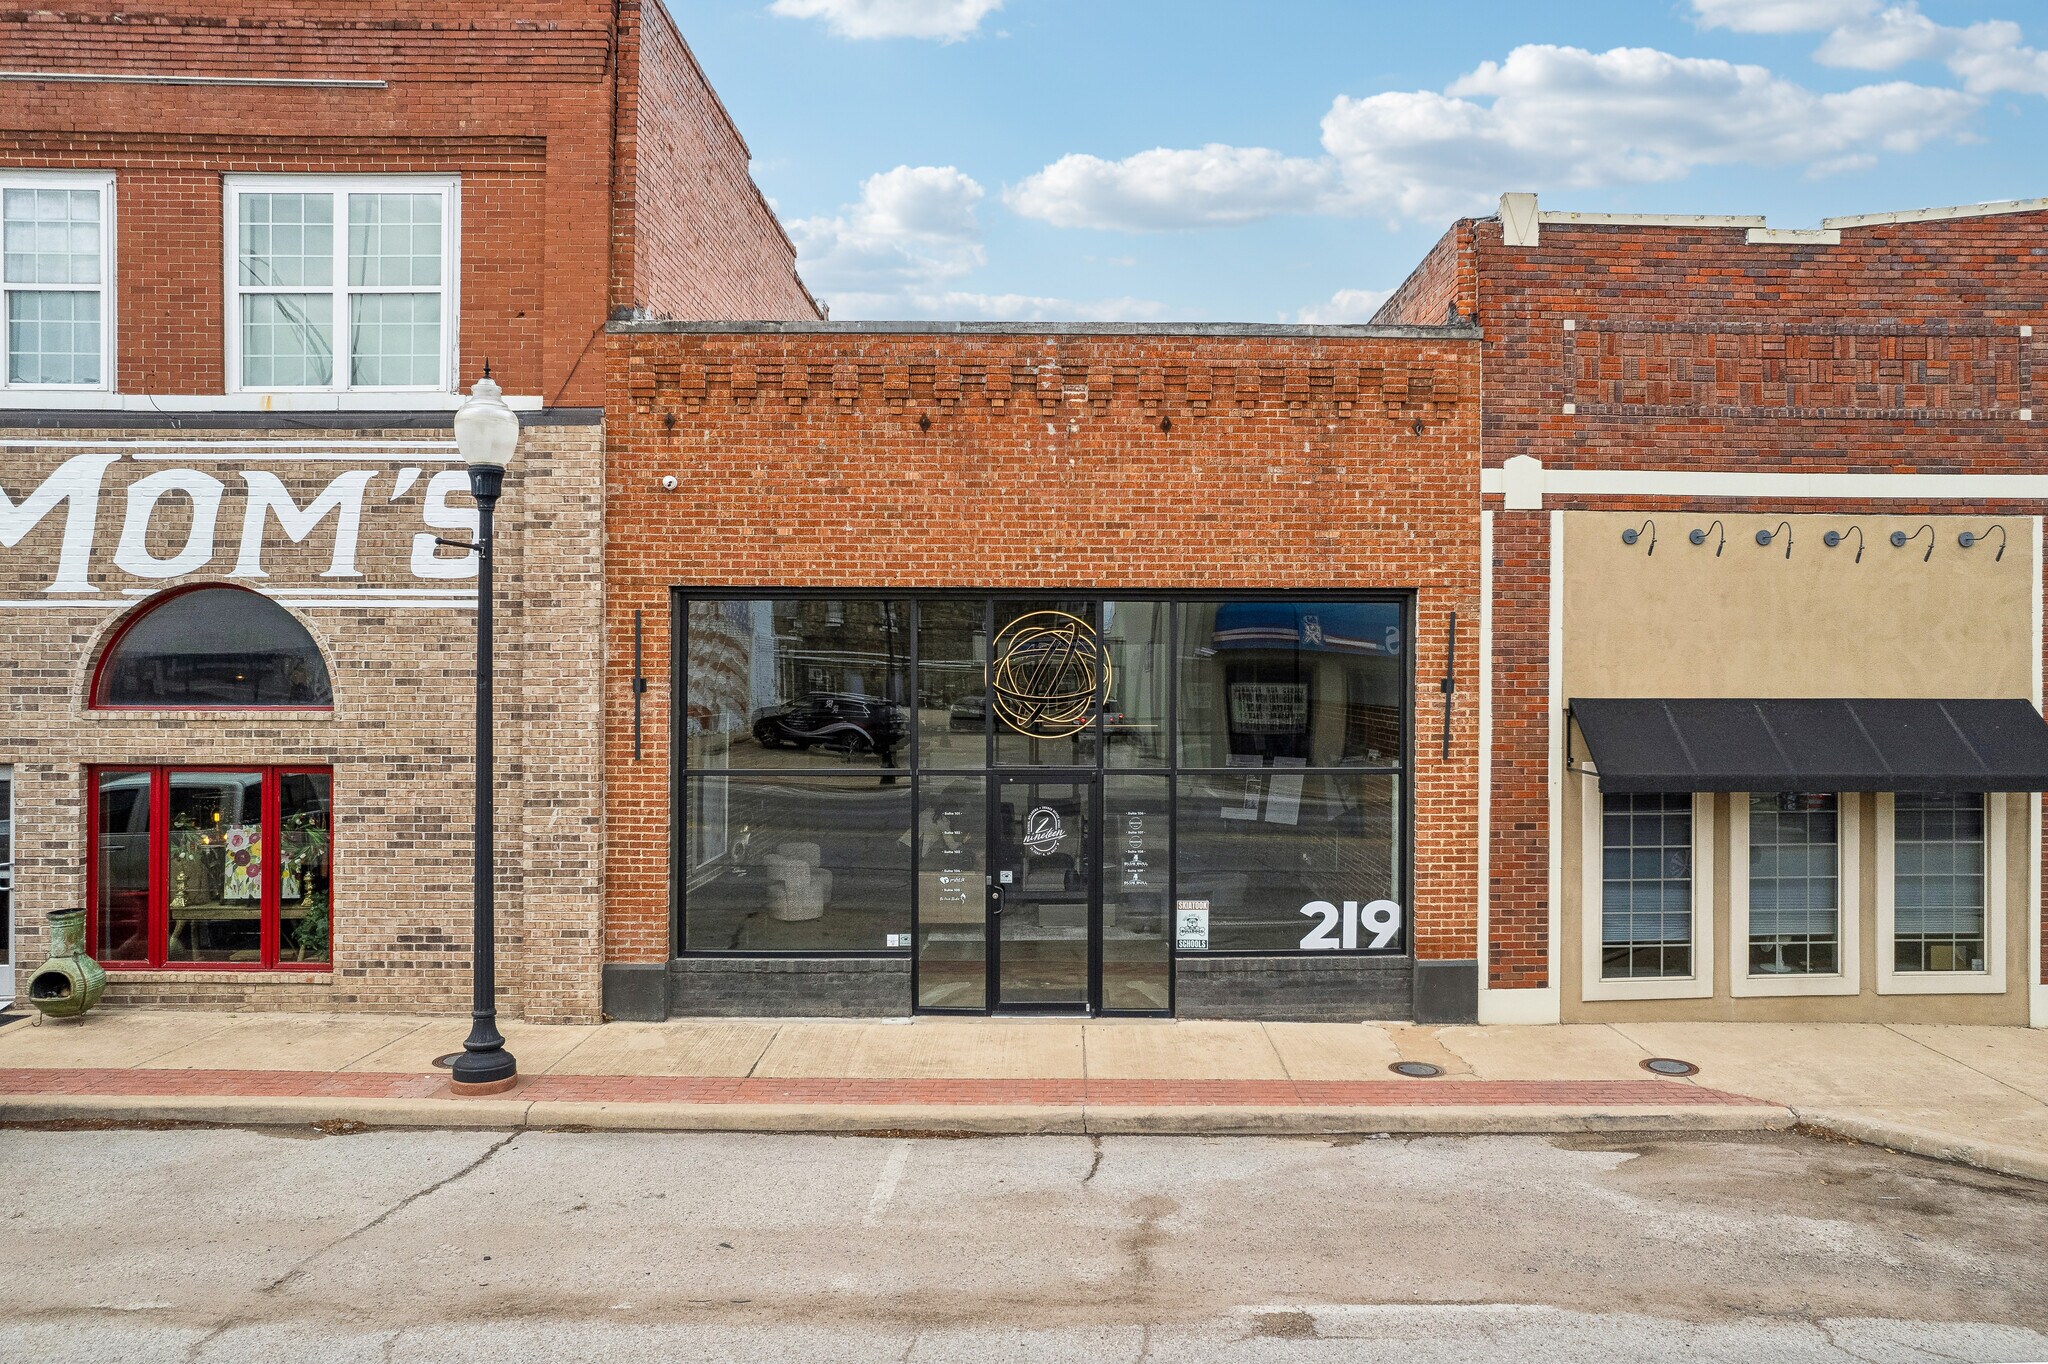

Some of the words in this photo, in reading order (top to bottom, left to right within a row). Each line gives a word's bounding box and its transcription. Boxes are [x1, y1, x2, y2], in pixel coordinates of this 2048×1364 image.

[1023, 828, 1066, 842] nineteen
[1178, 901, 1208, 910] SKIATOOK
[1300, 900, 1399, 949] 219
[1178, 940, 1207, 948] SCHOOLS
